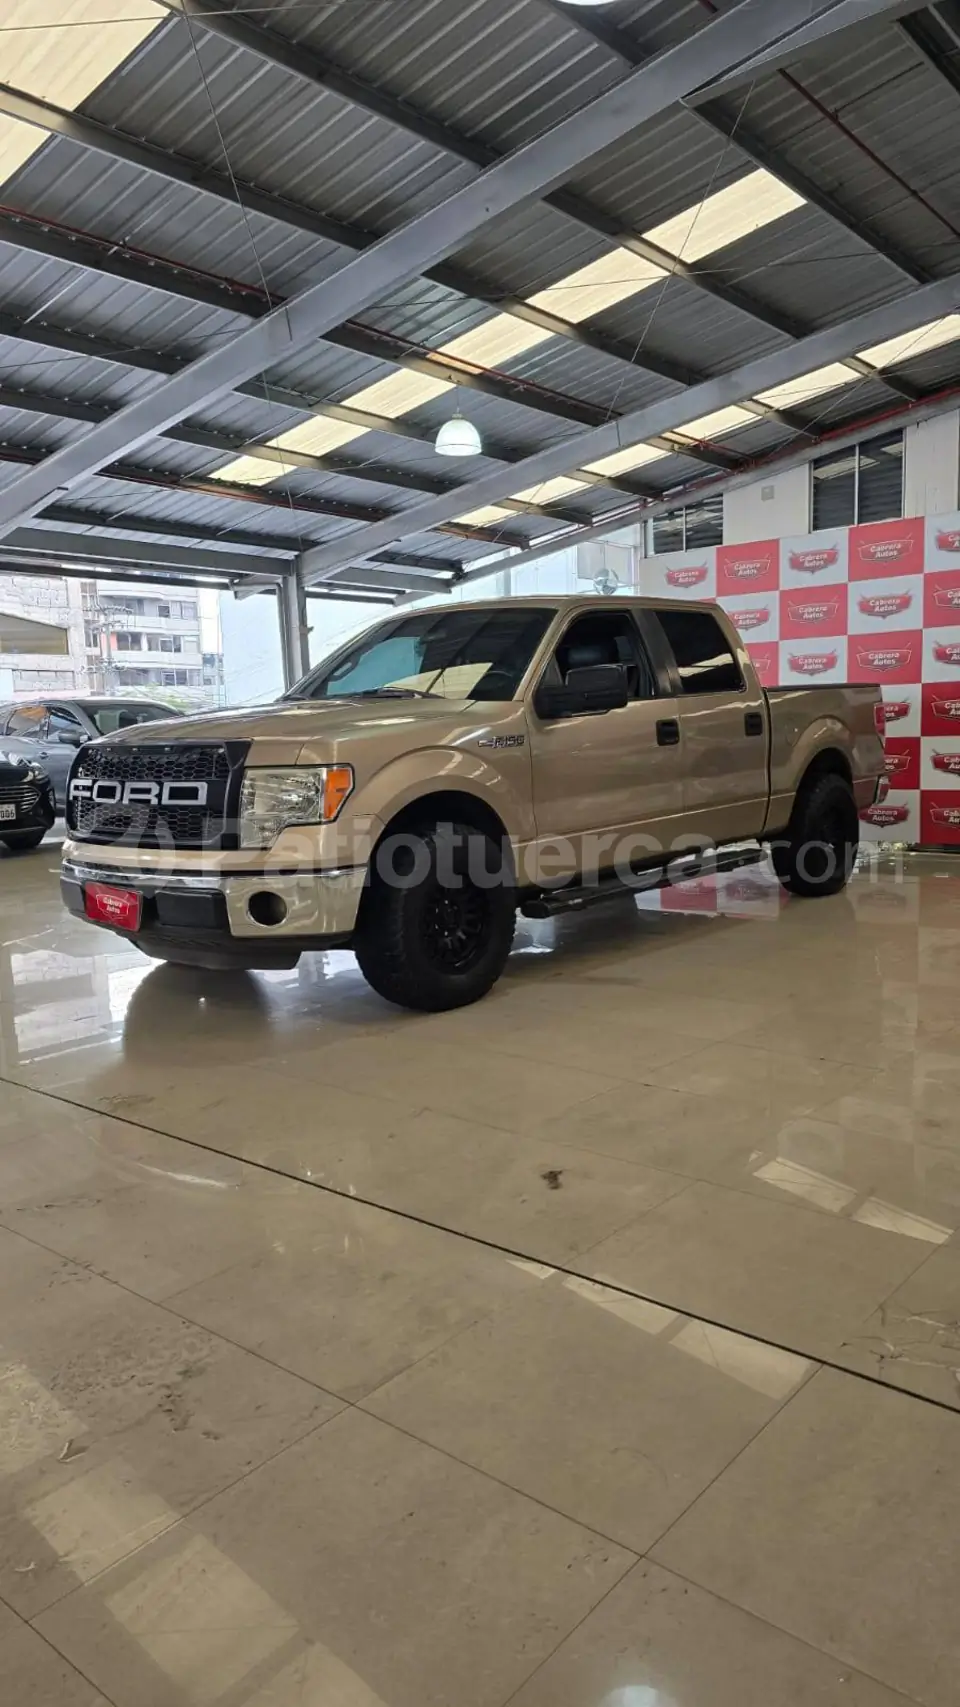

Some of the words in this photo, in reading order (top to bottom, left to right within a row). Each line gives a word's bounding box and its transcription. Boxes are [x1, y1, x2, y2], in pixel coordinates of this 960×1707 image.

[870, 543, 902, 552] Cabrera
[799, 553, 828, 562] Cabrera
[869, 599, 901, 607] Cabrera
[868, 652, 900, 660] Cabrera
[69, 778, 208, 805] FORD
